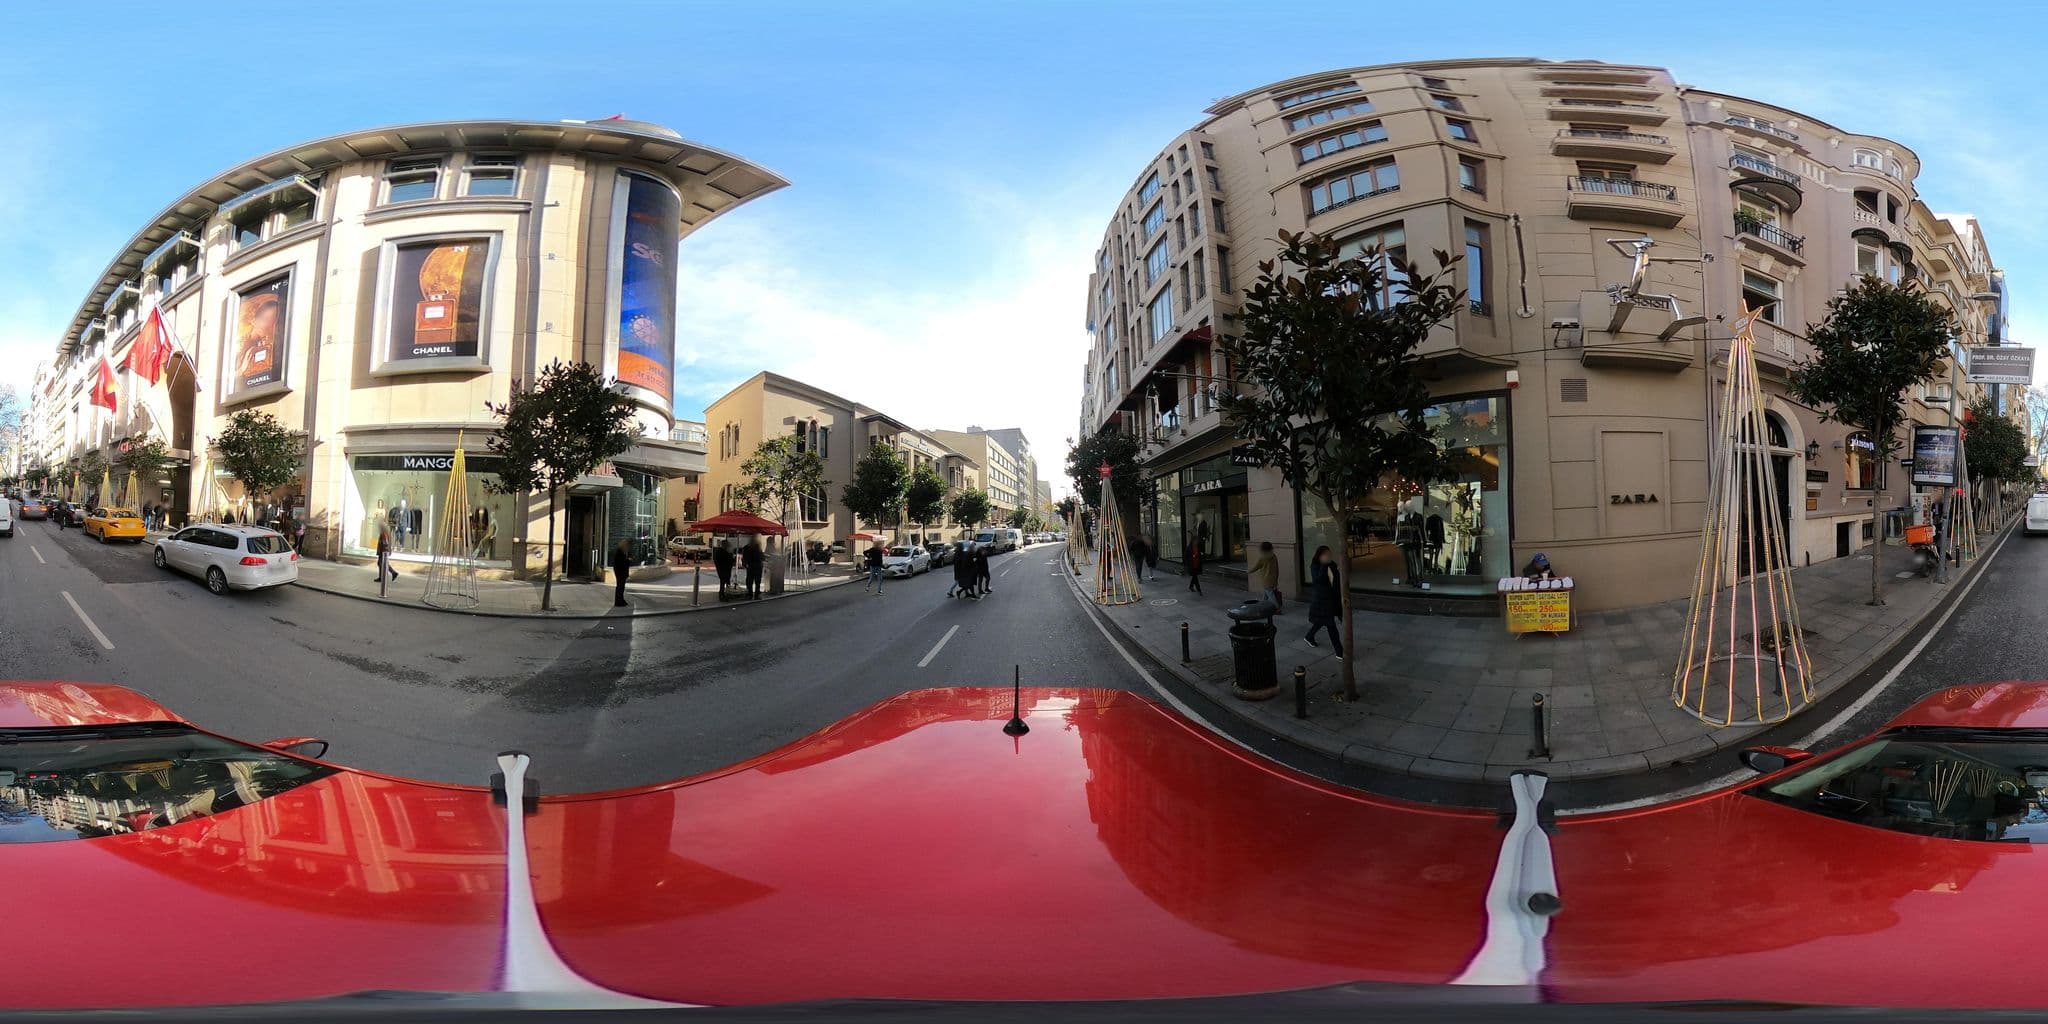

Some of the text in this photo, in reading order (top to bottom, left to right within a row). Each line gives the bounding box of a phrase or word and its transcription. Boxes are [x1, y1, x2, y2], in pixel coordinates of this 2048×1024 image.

[413, 346, 453, 355] CHANEL
[246, 374, 271, 386] CHANEL
[1234, 455, 1262, 464] ZARA
[1194, 479, 1223, 493] ZARA
[1611, 494, 1659, 505] ZARA
[1539, 605, 1554, 613] 250
